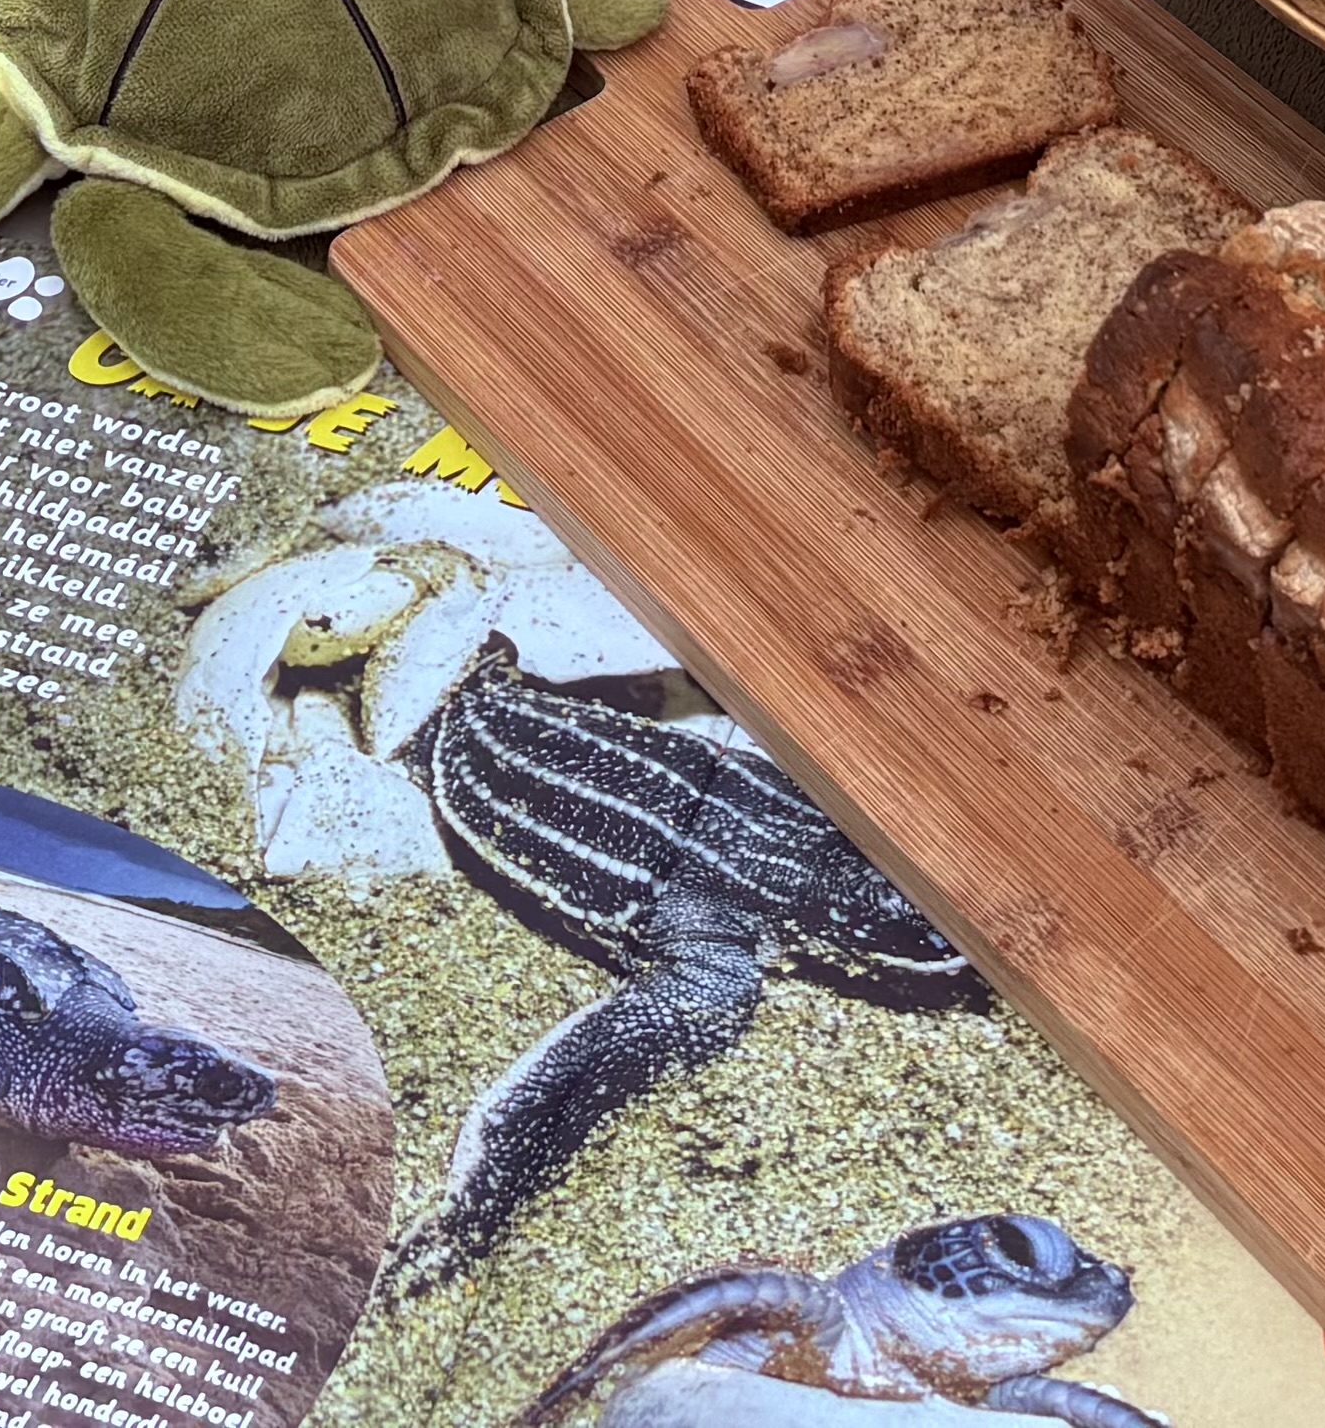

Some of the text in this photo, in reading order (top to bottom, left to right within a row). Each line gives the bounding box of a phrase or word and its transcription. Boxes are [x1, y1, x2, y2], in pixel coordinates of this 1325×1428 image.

[18, 427, 93, 460] niet
[104, 450, 242, 504] vanzelf.
[92, 413, 222, 464] worden
[30, 463, 112, 498] voor
[120, 482, 212, 532] baby
[2, 518, 178, 586] helemáál
[5, 598, 51, 623] ze
[59, 613, 146, 654] mee,
[37, 1234, 114, 1275] horen
[119, 1259, 147, 1285] in
[153, 1269, 201, 1301] het
[207, 1290, 287, 1334] water.
[11, 1267, 59, 1294] een
[64, 1283, 298, 1374] moederschildpad
[21, 1308, 109, 1346] graaft
[111, 1334, 145, 1356] ze
[149, 1346, 198, 1376] een
[204, 1359, 264, 1400] kuil
[79, 1360, 128, 1390] een
[133, 1371, 255, 1428] heleboel
